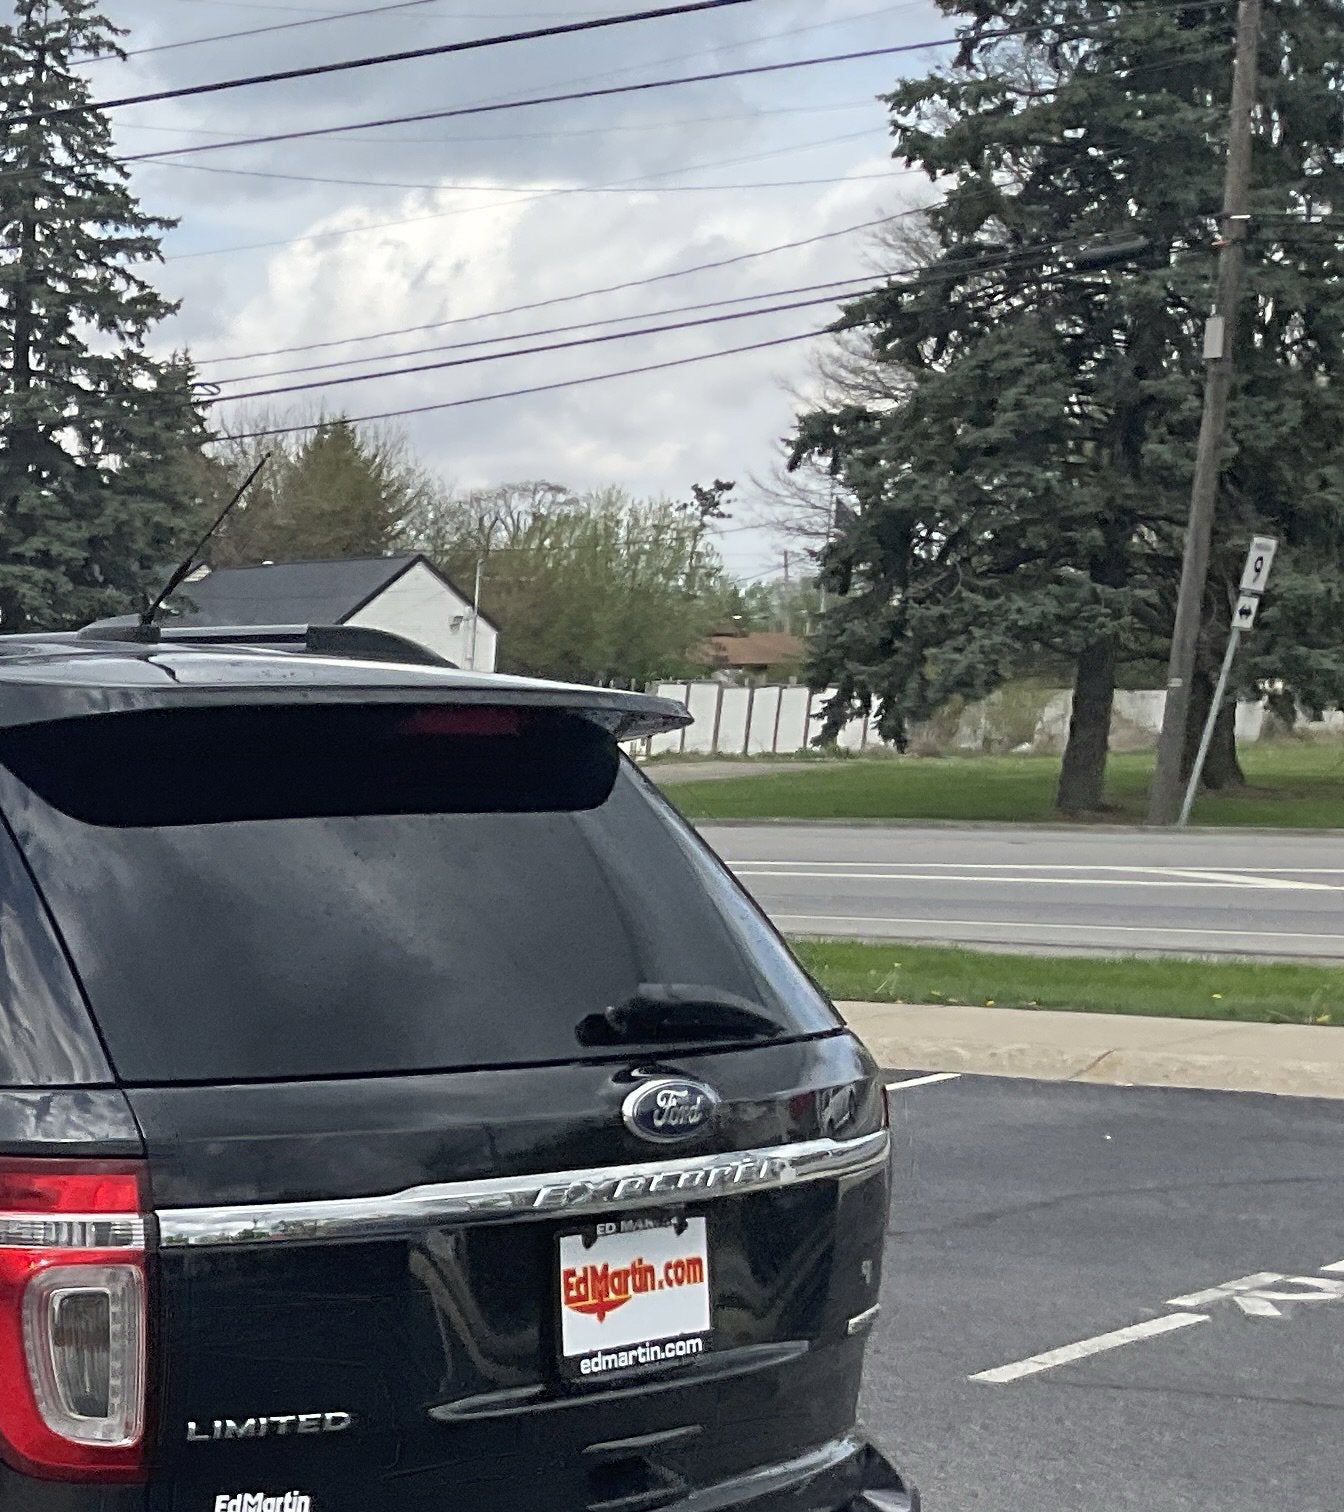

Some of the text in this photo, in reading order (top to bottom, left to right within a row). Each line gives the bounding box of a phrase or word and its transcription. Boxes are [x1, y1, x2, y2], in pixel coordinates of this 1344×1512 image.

[1252, 555, 1264, 584] 9
[653, 1089, 703, 1128] Ford
[596, 1222, 617, 1235] ED
[563, 1256, 704, 1306] EdMartin.com
[580, 1336, 703, 1375] edmartin.com
[187, 1411, 352, 1442] LIMITED
